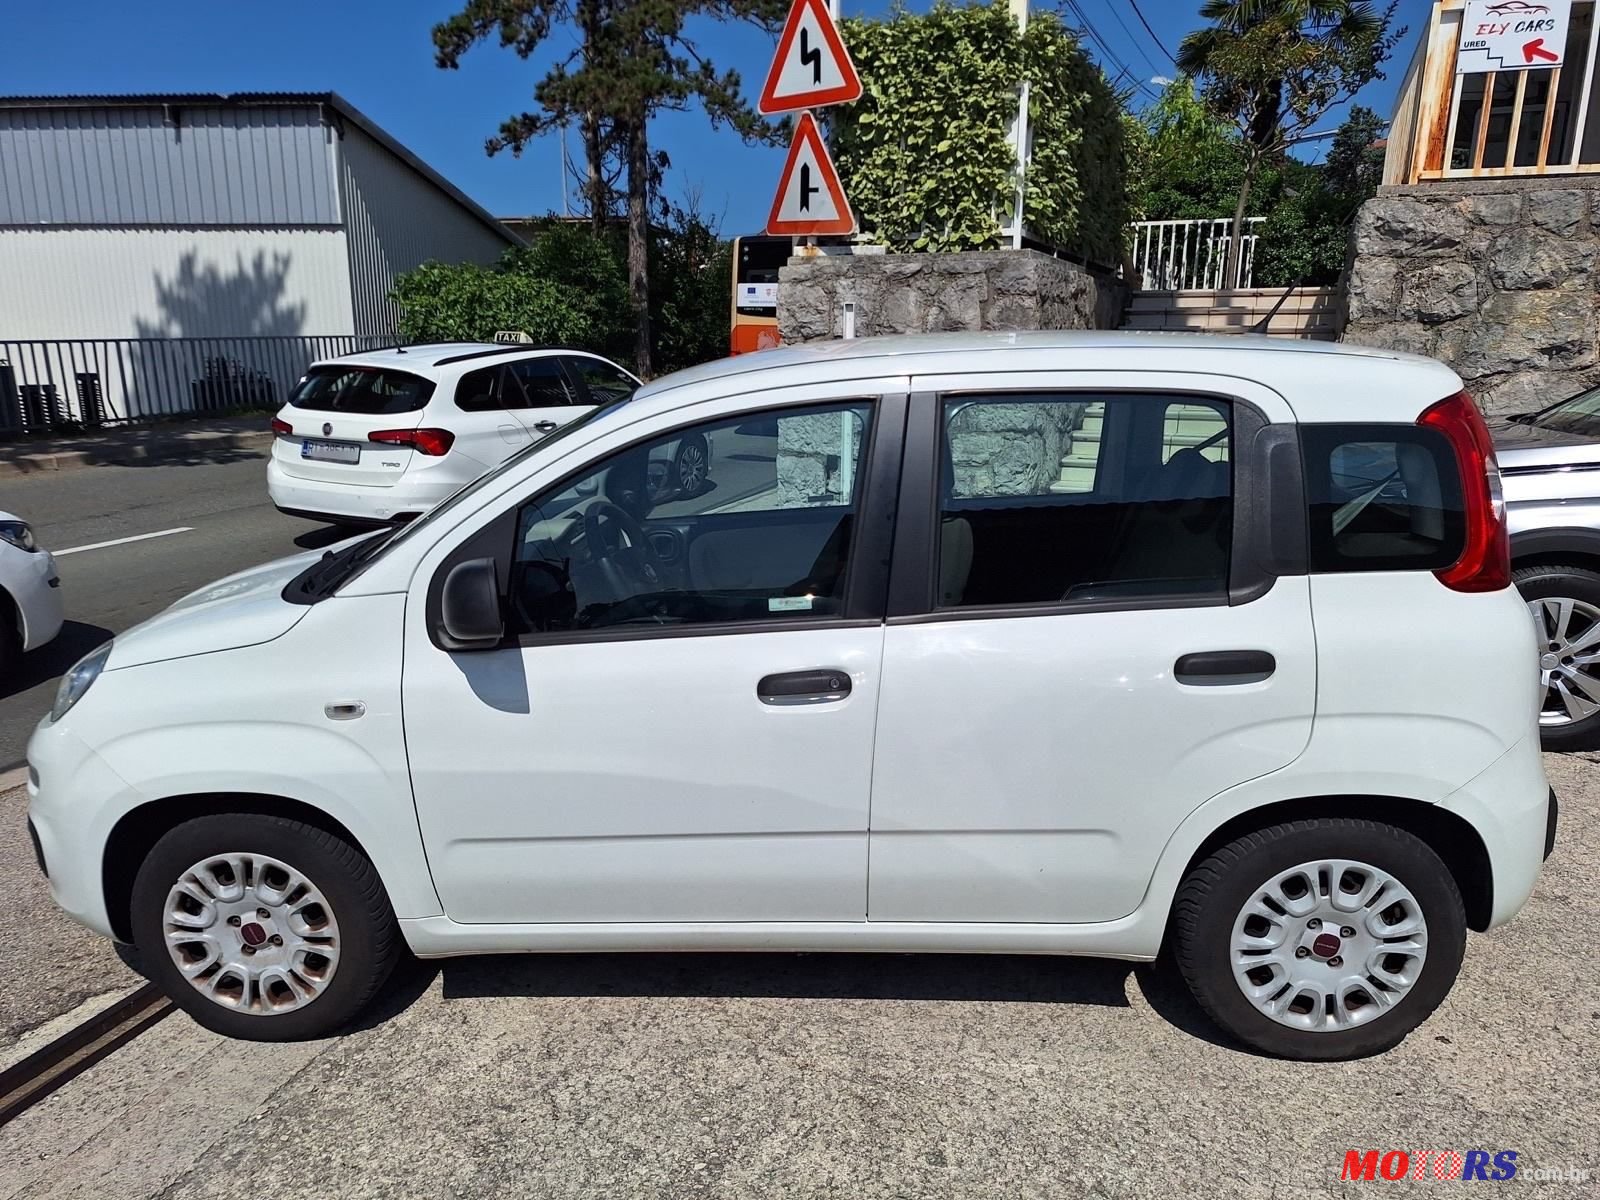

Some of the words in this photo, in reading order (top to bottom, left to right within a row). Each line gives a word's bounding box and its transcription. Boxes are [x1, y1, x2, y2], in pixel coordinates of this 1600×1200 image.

[1476, 22, 1510, 35] ELY
[1514, 19, 1555, 33] CARS
[1464, 40, 1487, 48] URED
[498, 333, 520, 342] TAXI
